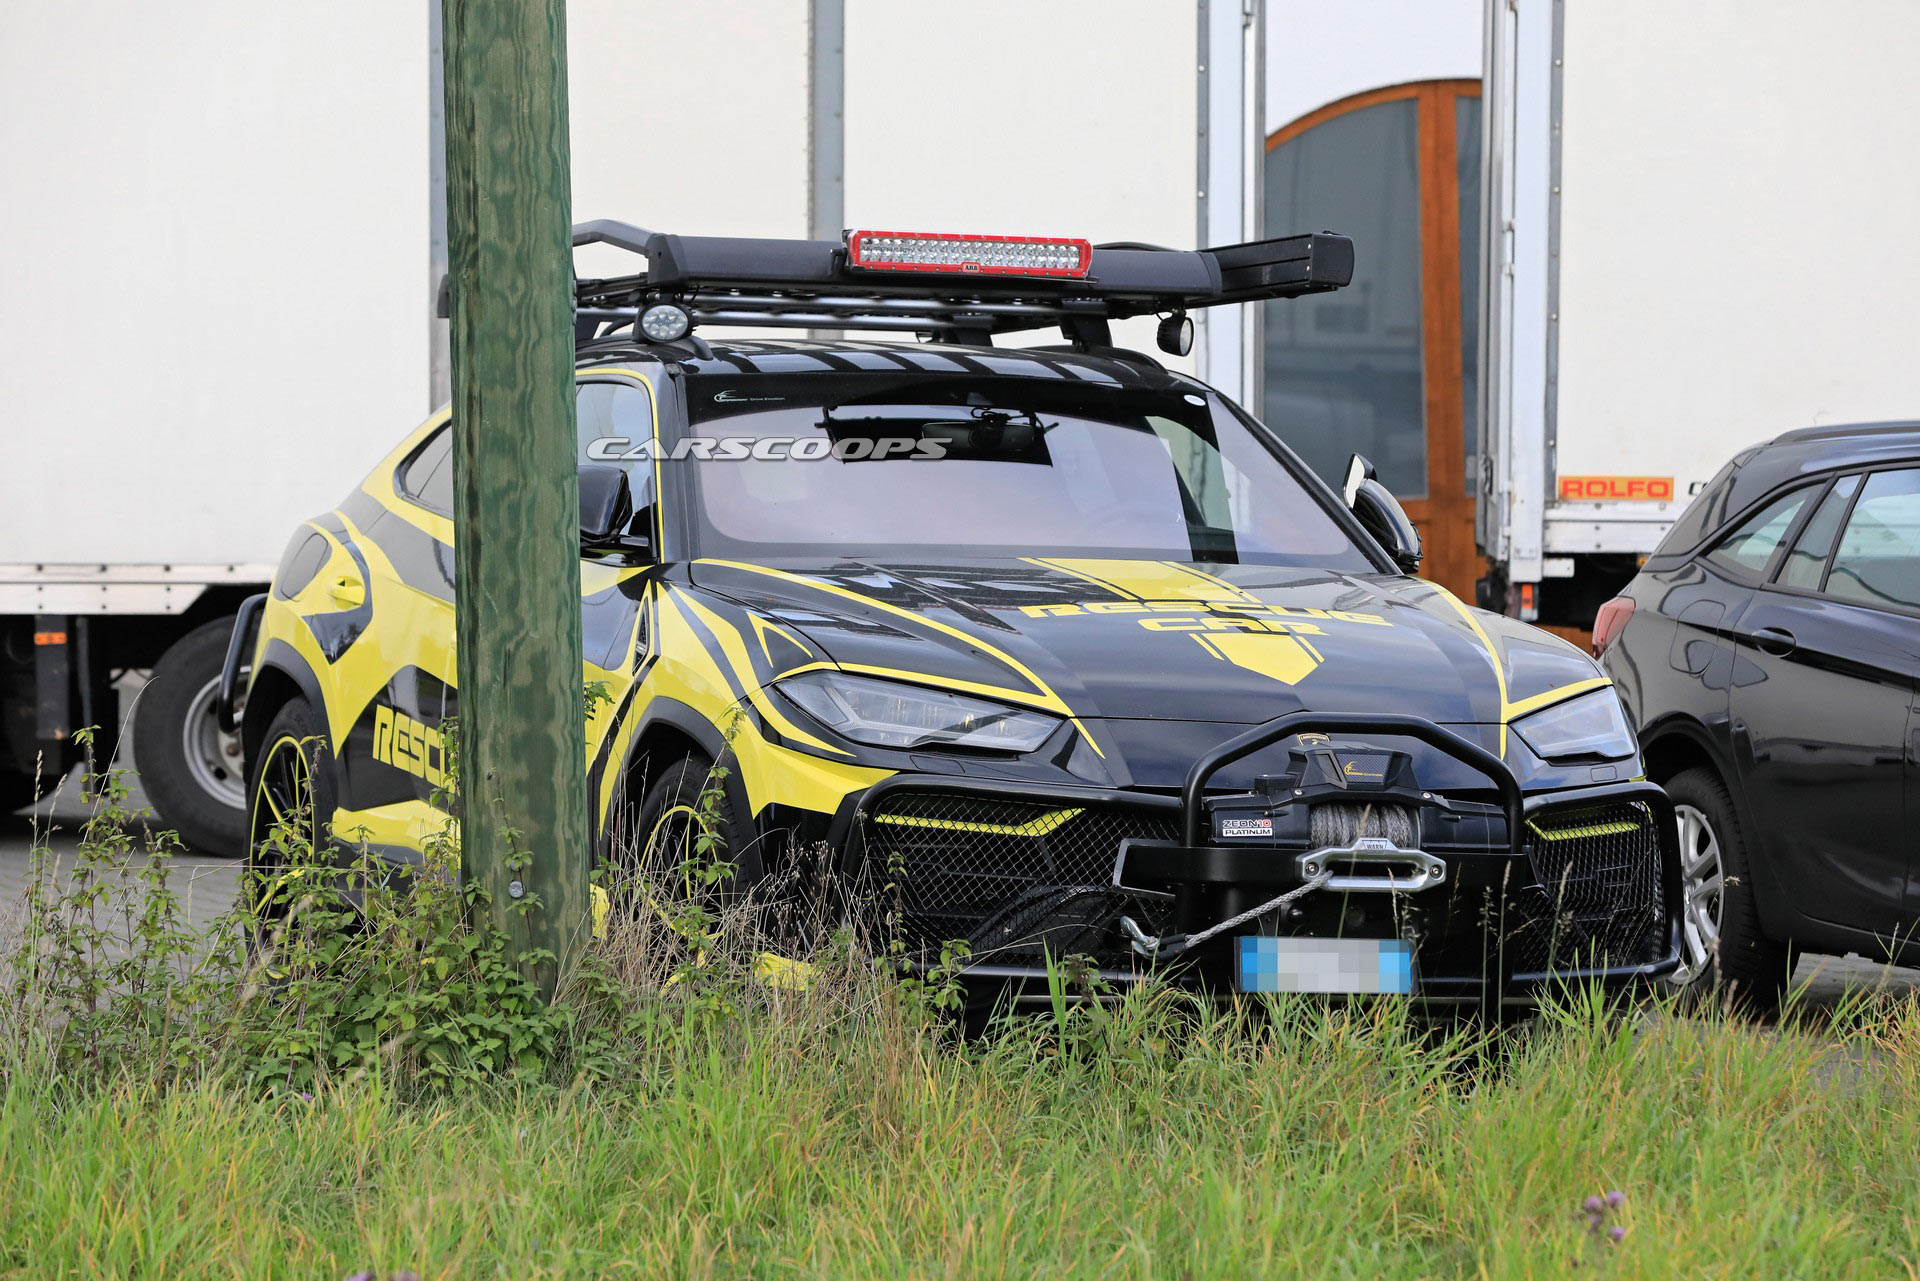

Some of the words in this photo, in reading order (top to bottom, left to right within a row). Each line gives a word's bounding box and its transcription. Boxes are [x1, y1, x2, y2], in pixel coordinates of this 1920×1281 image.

[1562, 480, 1669, 497] ROLFO
[1017, 601, 1394, 627] RESCUE
[1138, 617, 1330, 637] CAR
